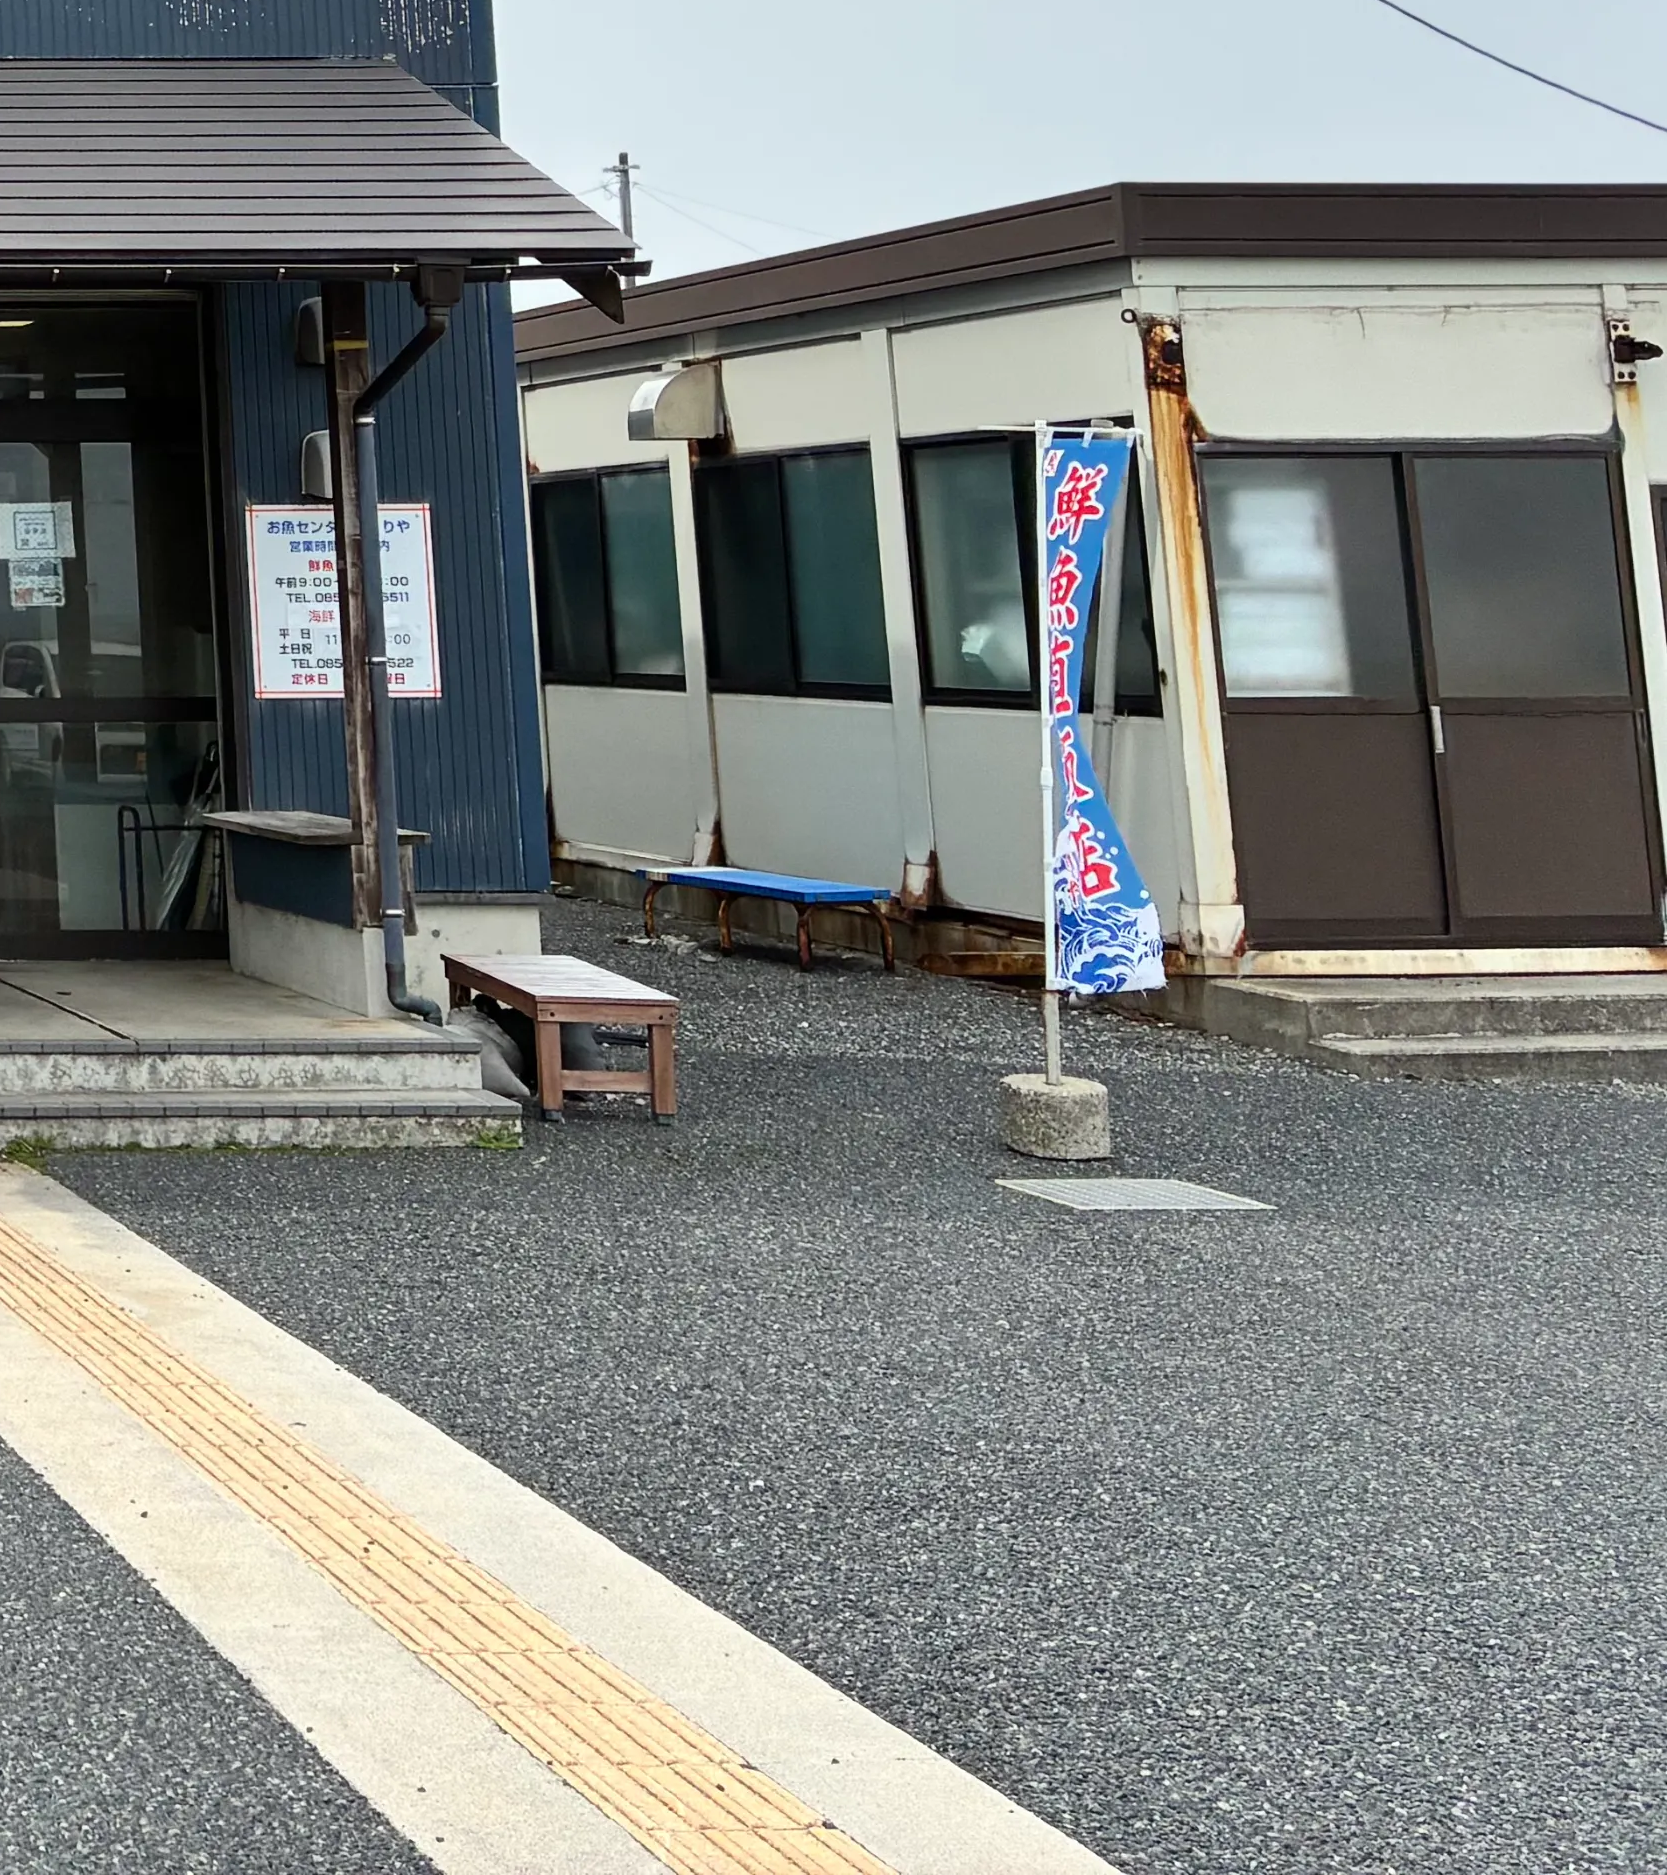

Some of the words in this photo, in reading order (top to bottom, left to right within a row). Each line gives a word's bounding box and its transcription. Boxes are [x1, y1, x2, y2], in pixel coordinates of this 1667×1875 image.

[279, 643, 313, 655] 土日祝
[292, 673, 328, 685] 定休日
